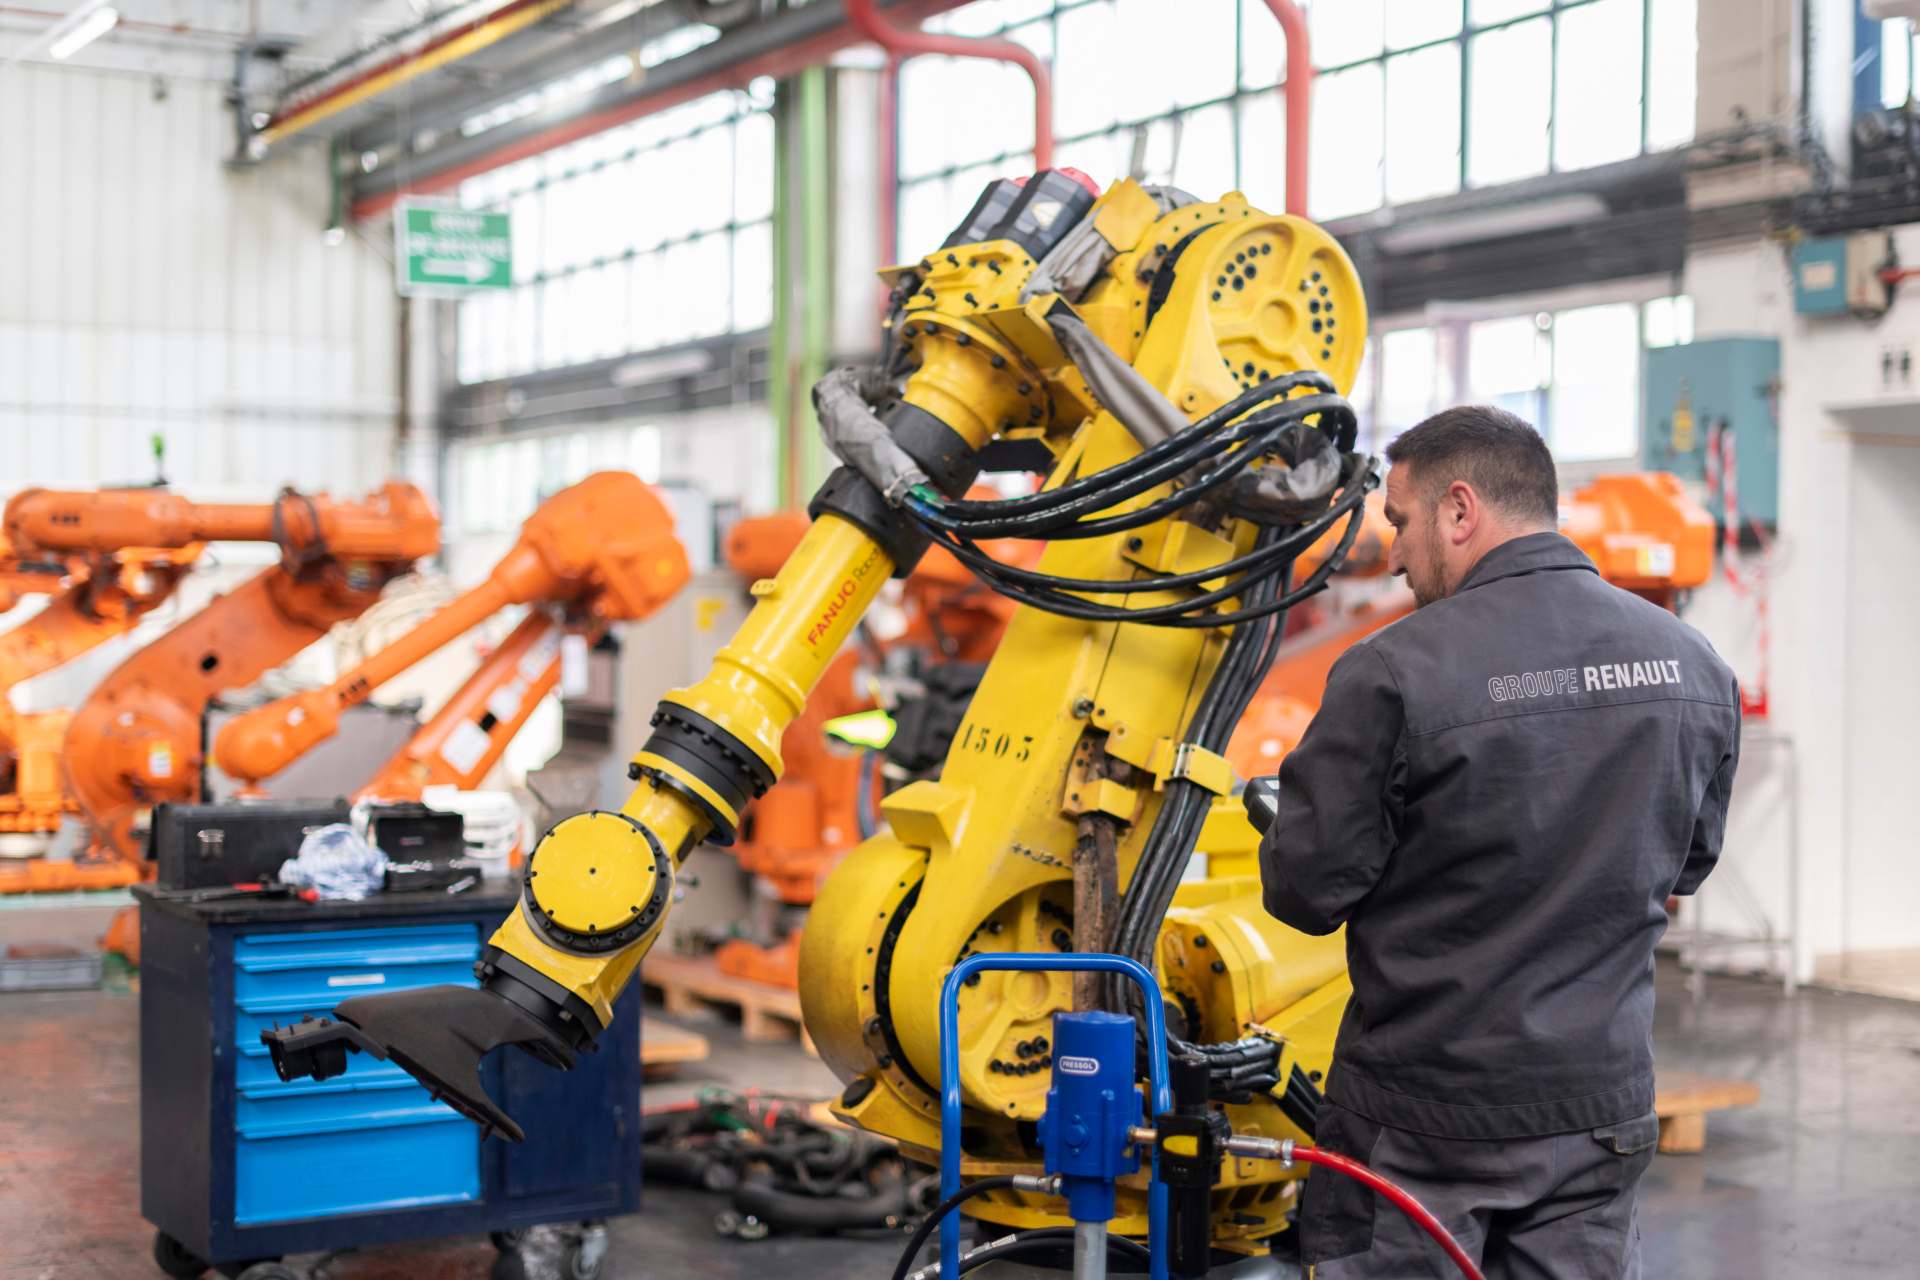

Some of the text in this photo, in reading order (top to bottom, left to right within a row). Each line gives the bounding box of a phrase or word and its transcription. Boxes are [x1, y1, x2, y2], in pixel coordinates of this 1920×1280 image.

[807, 579, 856, 646] FANUC
[1488, 660, 1681, 702] GROUPE RENAULT
[962, 723, 1034, 762] 1505
[1061, 1060, 1094, 1071] PRESSOL
